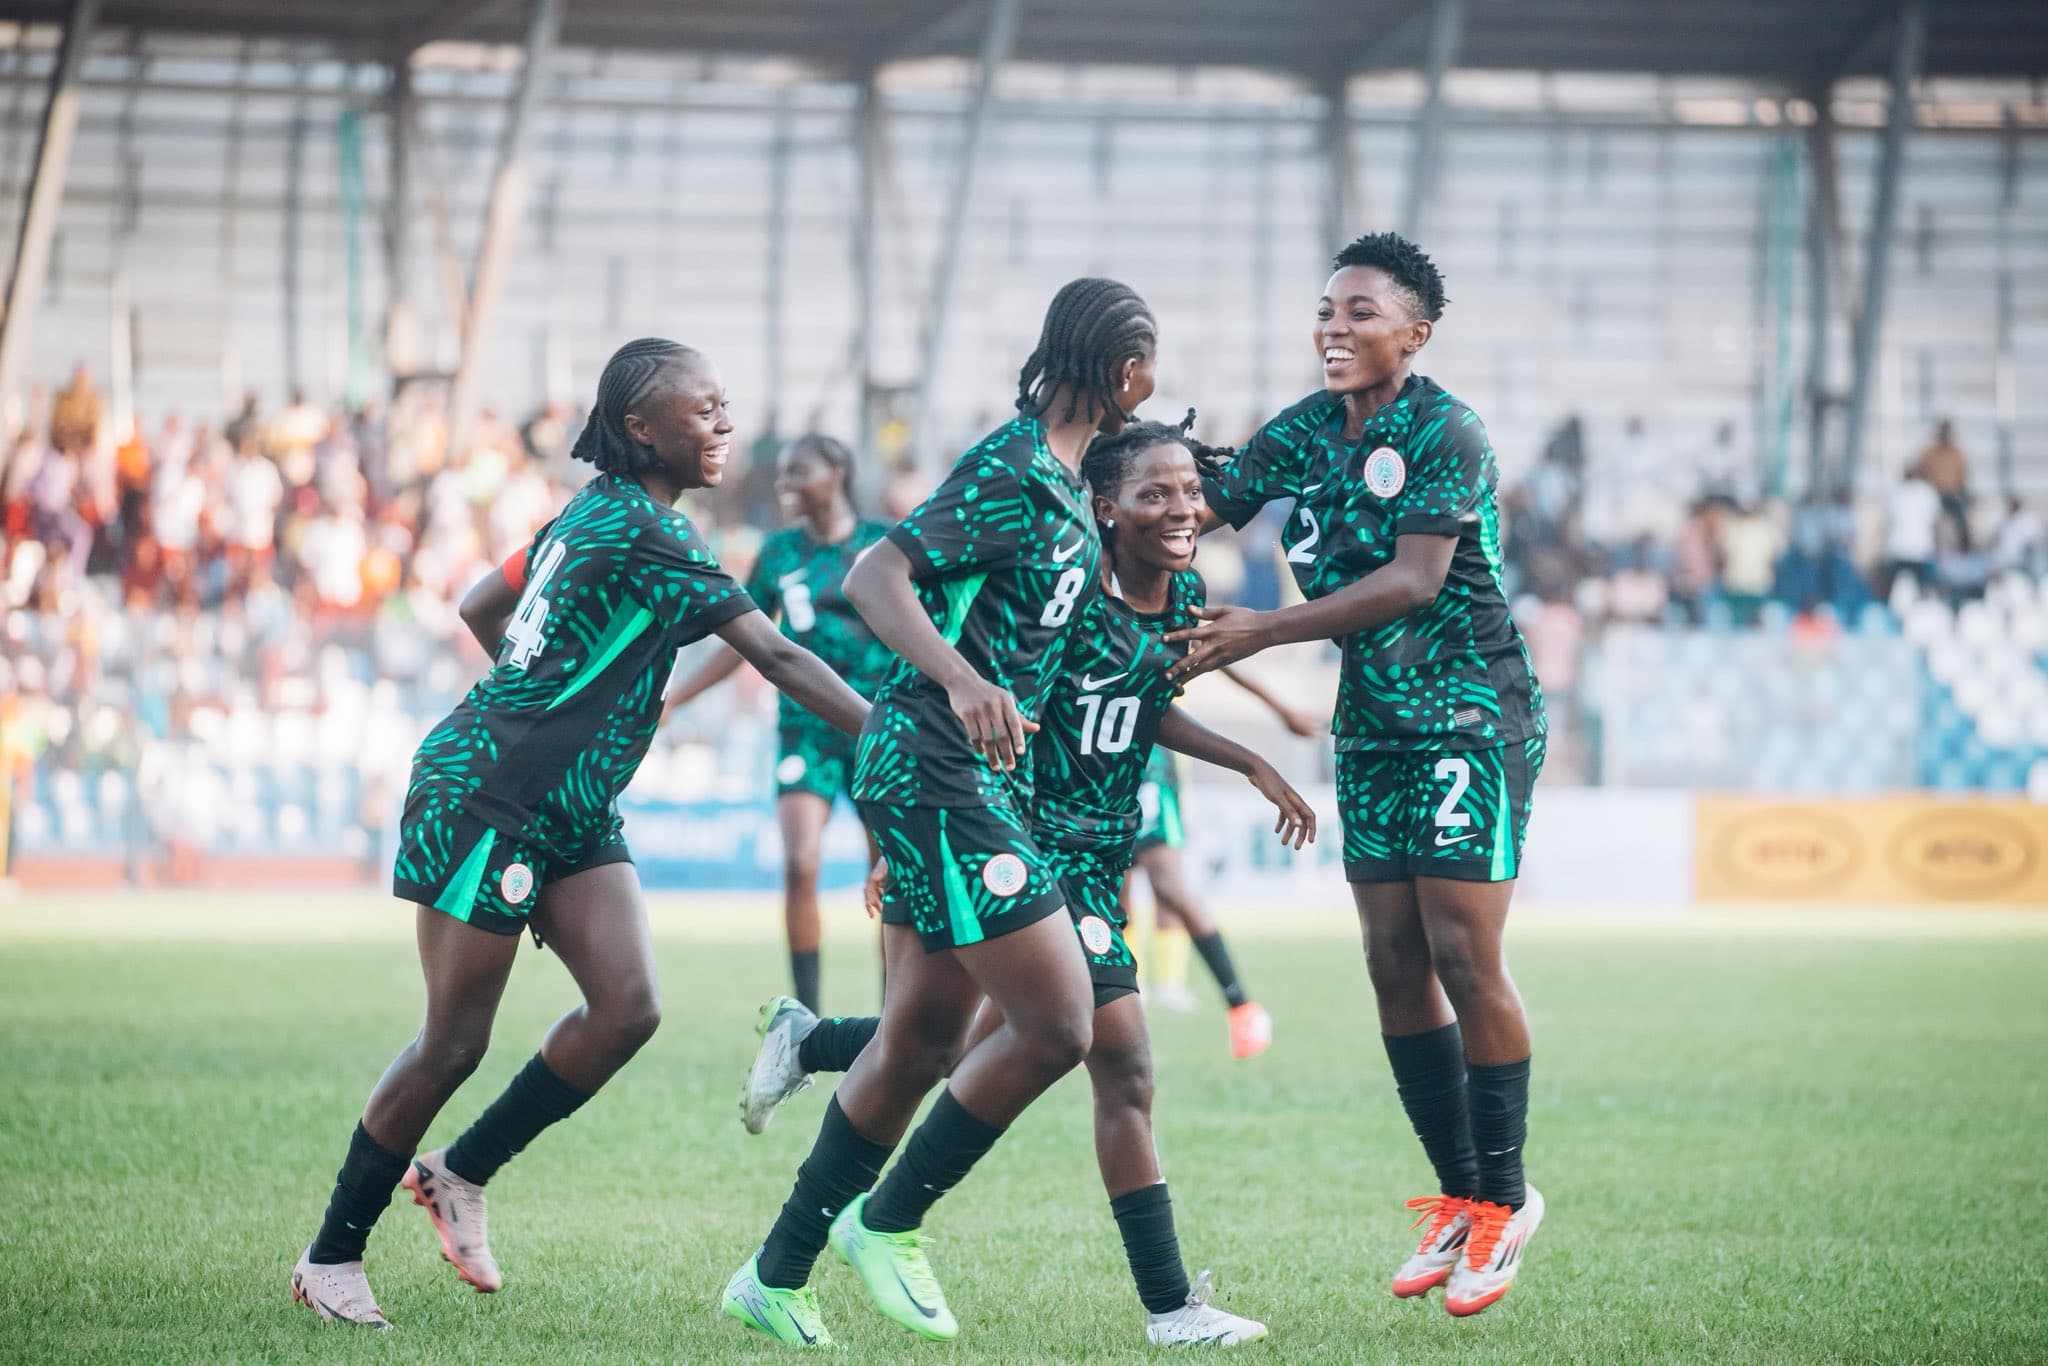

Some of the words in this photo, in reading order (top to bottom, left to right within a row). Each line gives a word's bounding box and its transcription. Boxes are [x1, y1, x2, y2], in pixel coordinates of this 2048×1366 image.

[1288, 508, 1319, 564] 2
[505, 536, 566, 671] 4
[1040, 568, 1085, 628] 8
[1076, 694, 1141, 755] 10
[1434, 758, 1470, 826] 2
